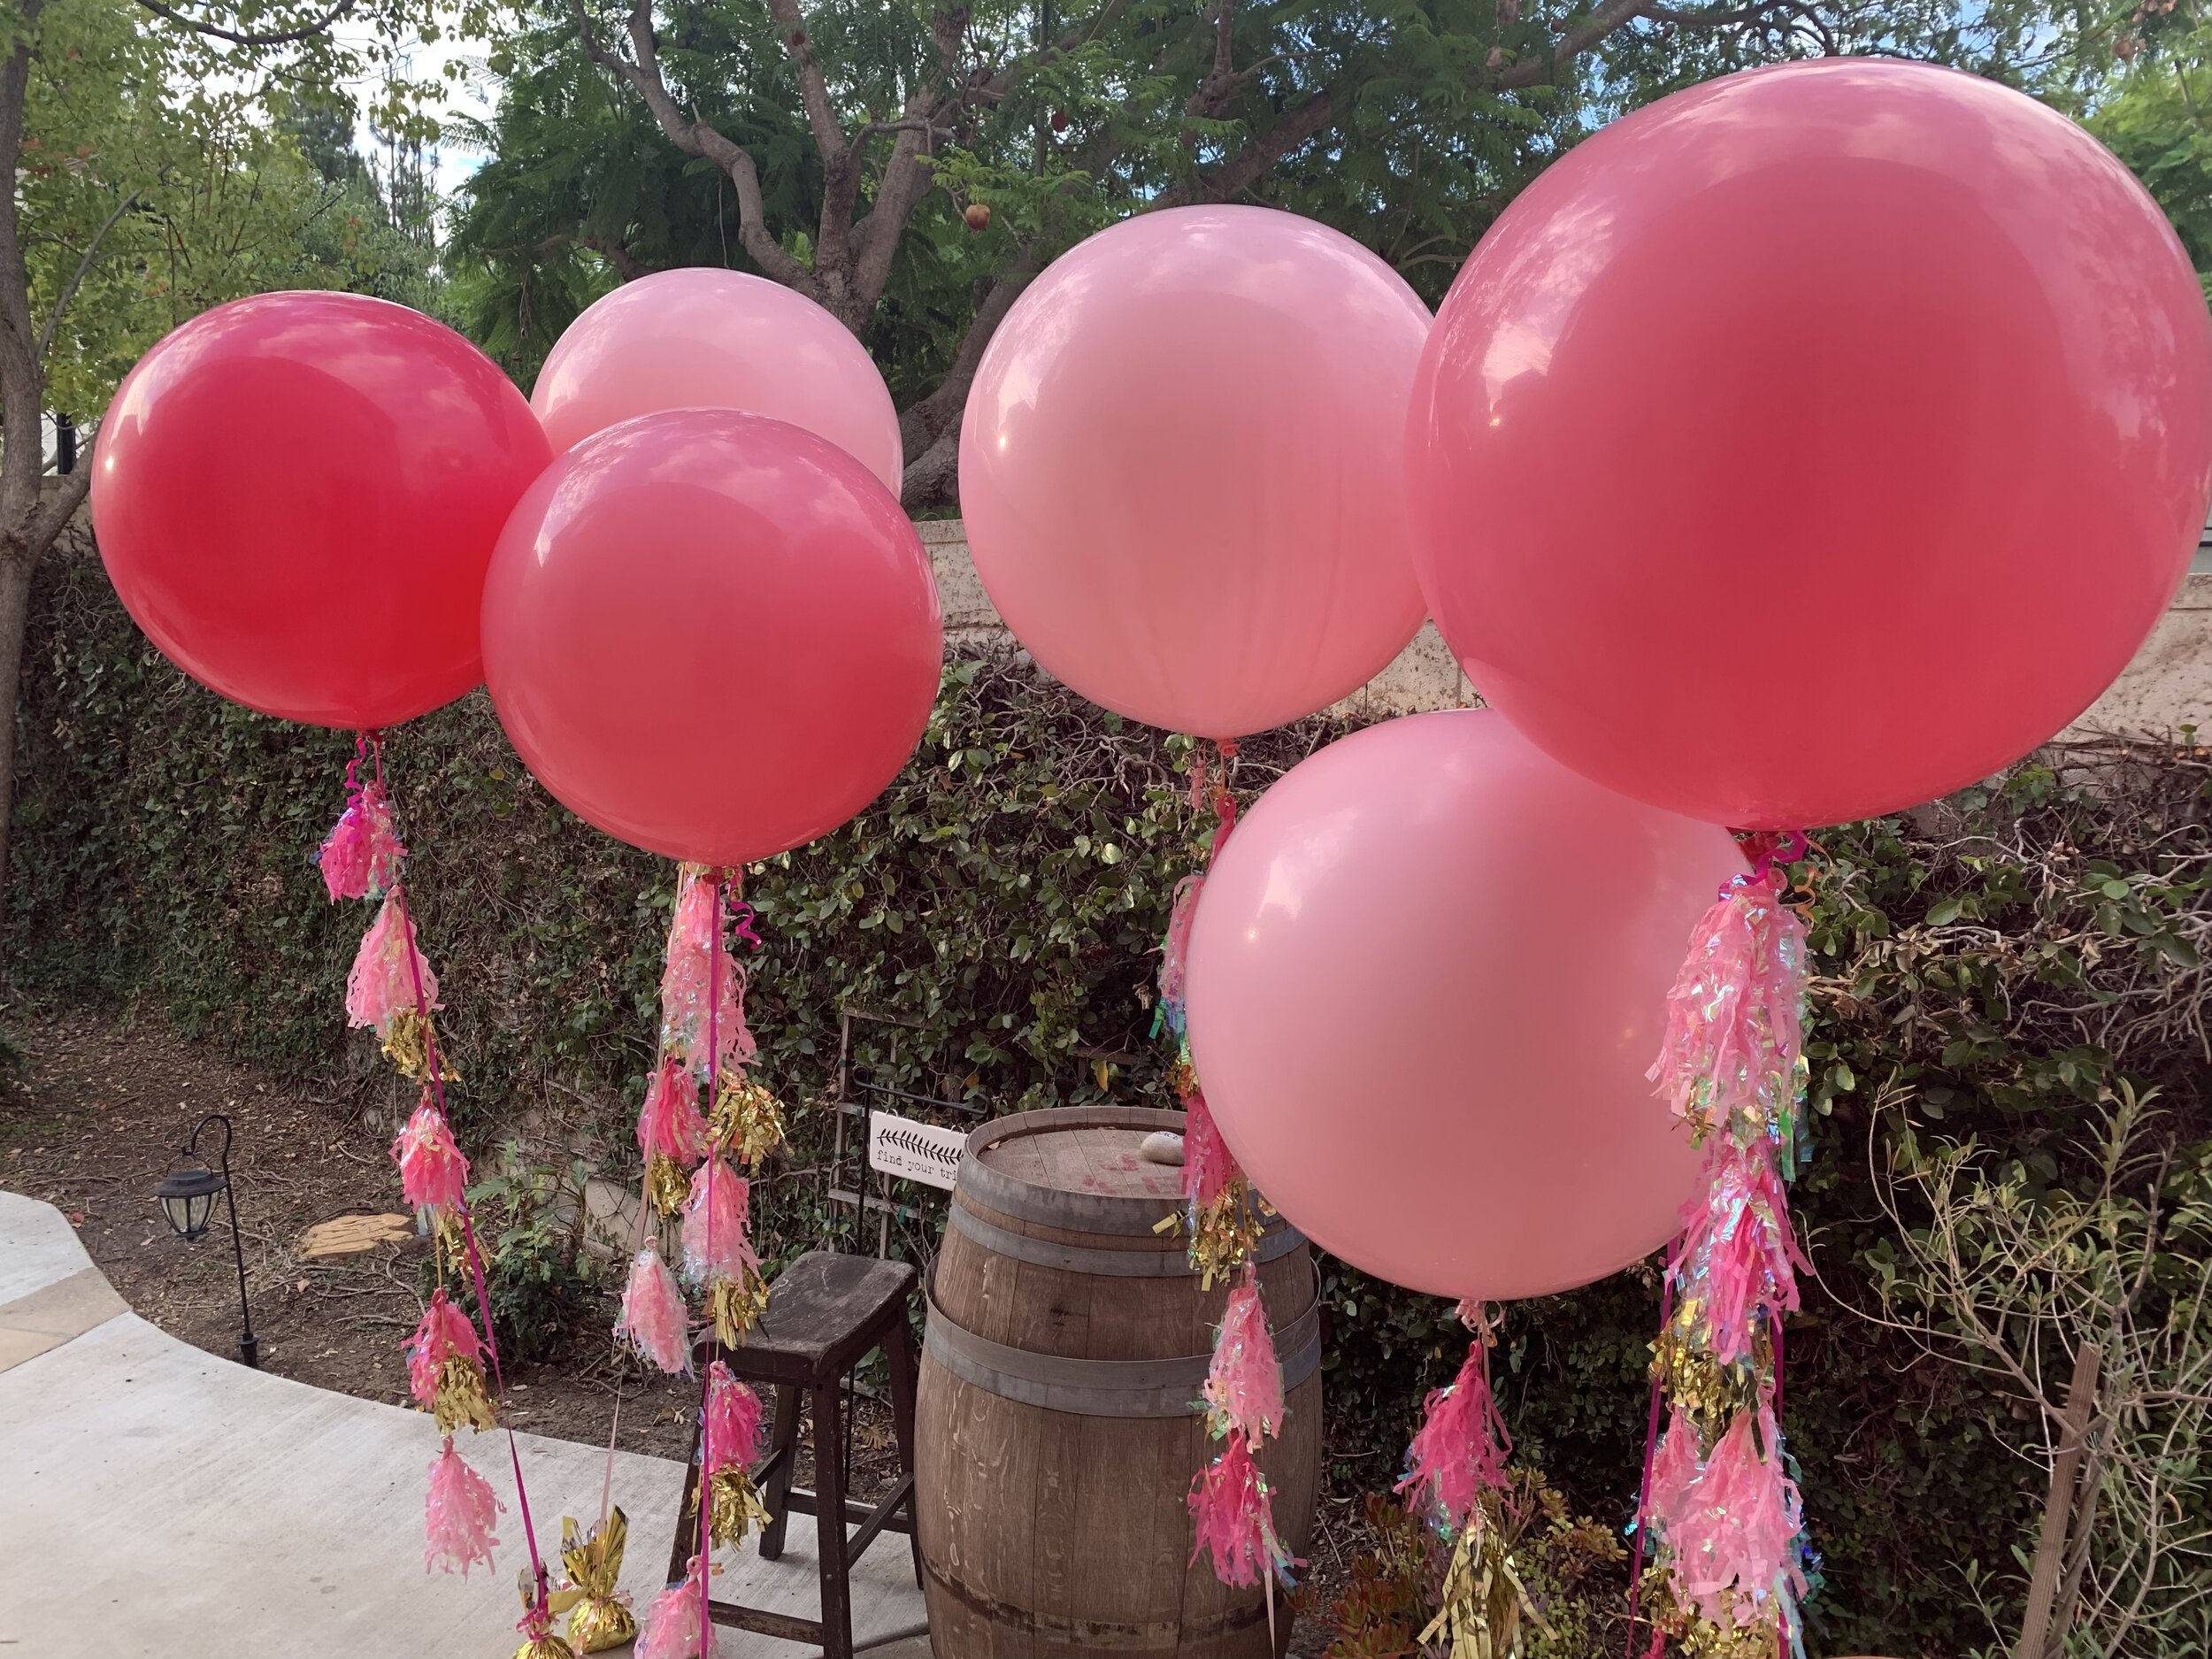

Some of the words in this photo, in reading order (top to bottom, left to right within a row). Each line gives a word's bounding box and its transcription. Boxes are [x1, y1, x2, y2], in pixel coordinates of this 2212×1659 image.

[877, 1149, 902, 1166] find
[907, 1161, 934, 1174] your
[940, 1167, 957, 1181] tri
